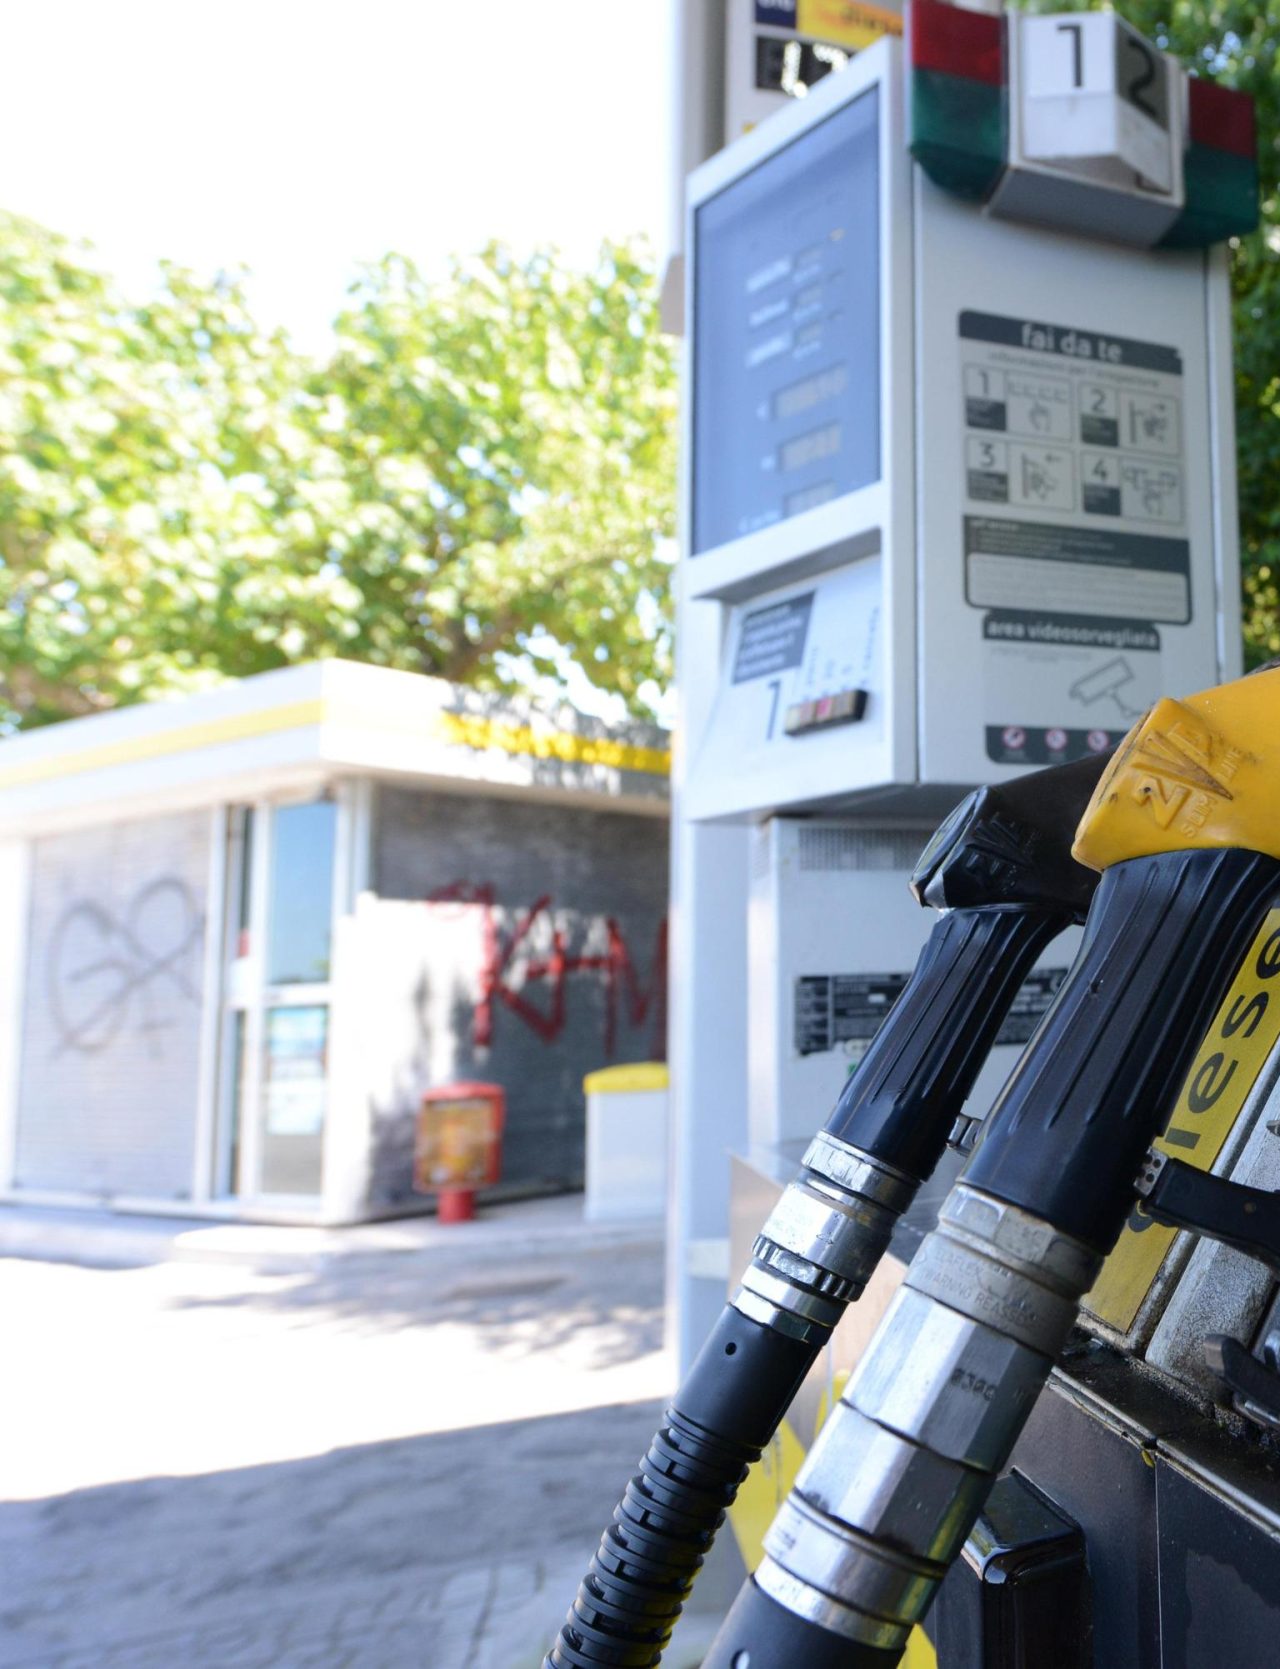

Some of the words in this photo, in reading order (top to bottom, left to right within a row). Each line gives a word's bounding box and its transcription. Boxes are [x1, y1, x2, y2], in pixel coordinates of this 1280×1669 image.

[1056, 23, 1083, 88] 1
[1127, 35, 1158, 118] 2
[1021, 322, 1056, 350] fai
[1059, 331, 1092, 357] da
[1097, 340, 1123, 363] te
[977, 371, 990, 398] 1
[1091, 388, 1107, 413] 2
[978, 442, 995, 468] 3
[1092, 460, 1108, 481] 4
[986, 619, 1026, 639] area
[766, 679, 781, 741] 1
